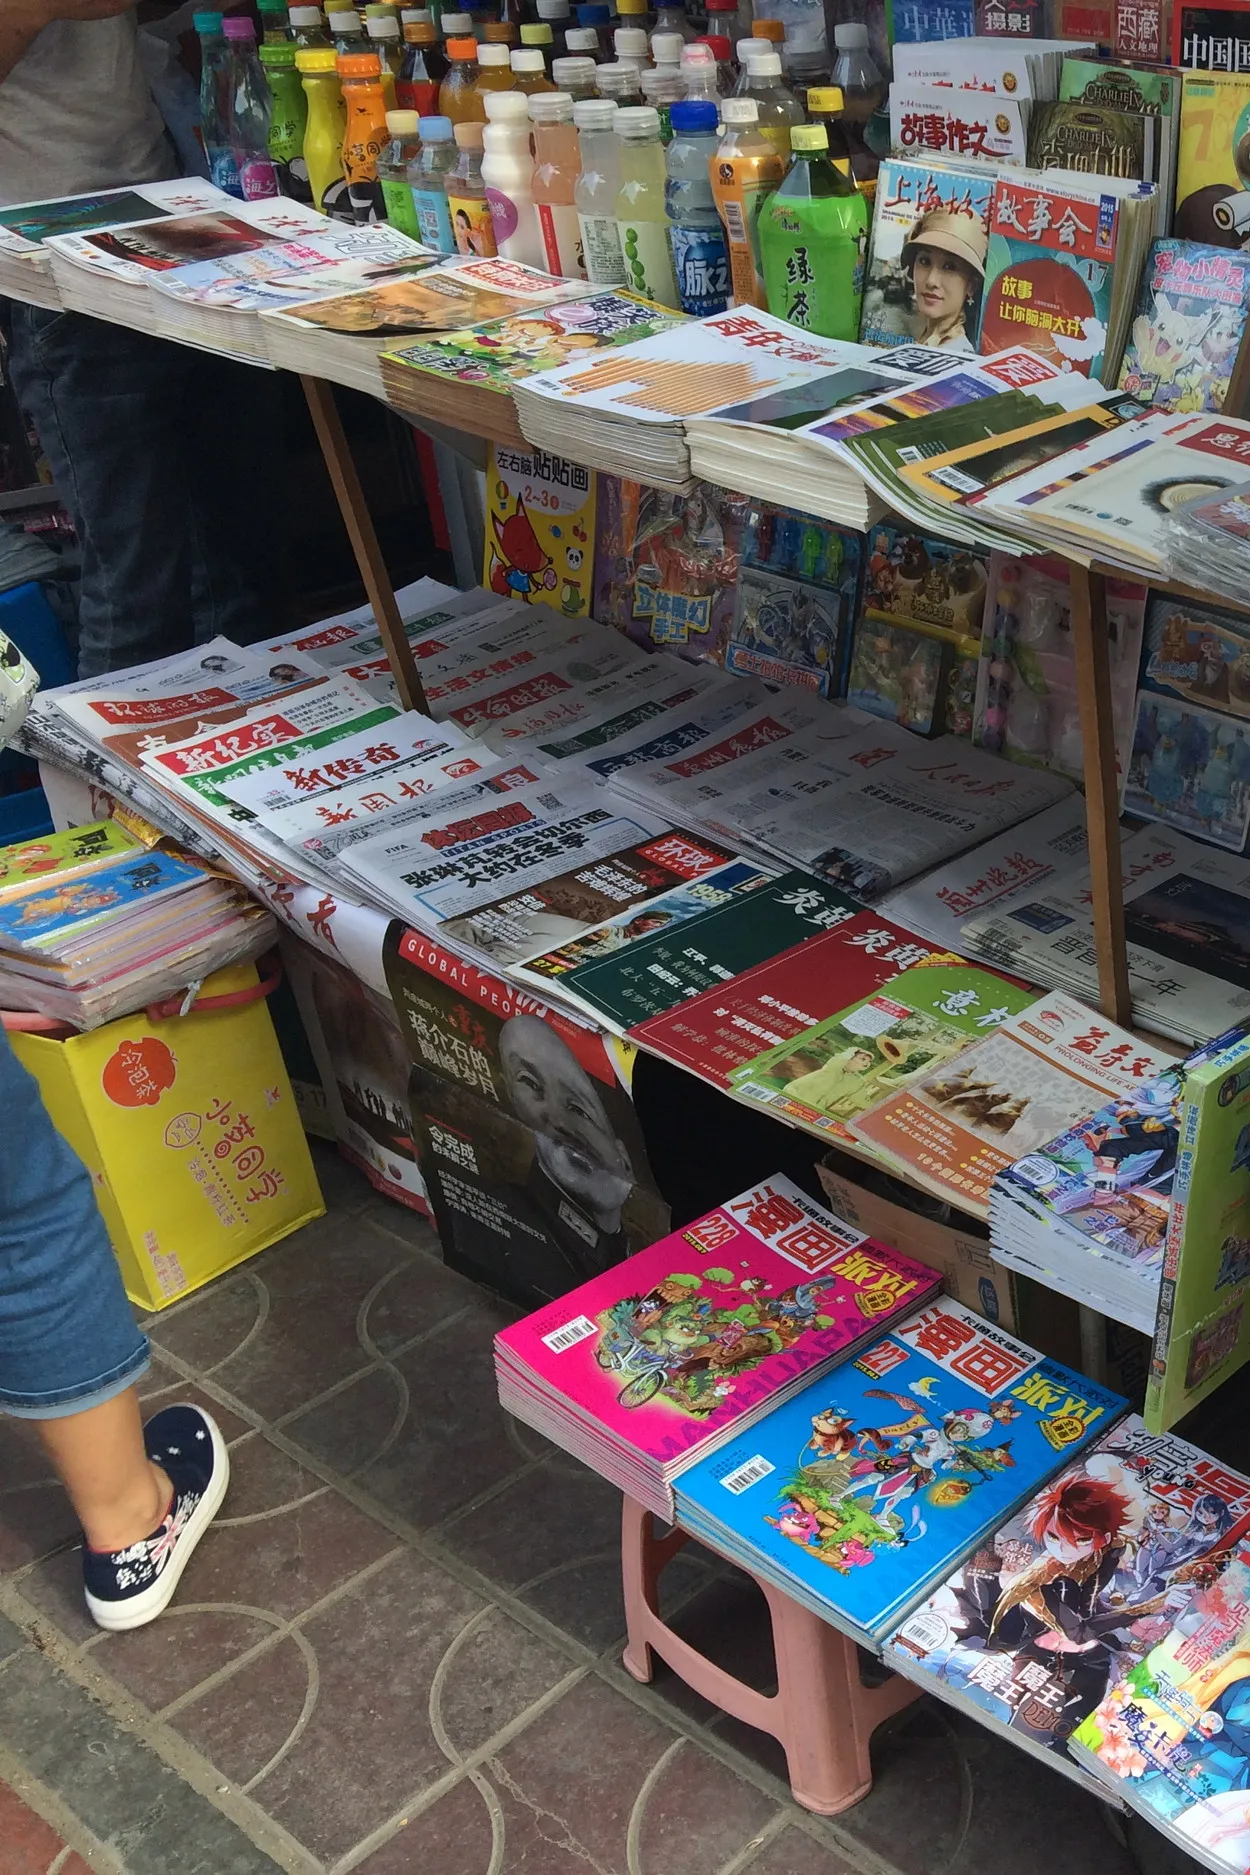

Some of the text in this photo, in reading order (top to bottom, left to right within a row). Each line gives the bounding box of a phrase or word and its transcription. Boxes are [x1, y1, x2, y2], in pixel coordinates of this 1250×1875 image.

[985, 12, 1030, 32] 摄影
[1118, 6, 1158, 41] 西藏
[900, 112, 1013, 157] 故事作文
[997, 188, 1093, 248] 故事会
[785, 247, 815, 327] 绿茶
[1002, 275, 1033, 300] 故事
[1086, 262, 1108, 285] 17
[1154, 251, 1244, 291] 宠物小精灵
[999, 301, 1081, 337] 让你脑洞大开
[497, 450, 589, 493] 左右脑贴贴画
[175, 722, 294, 773] 新纪实
[283, 743, 401, 792] 新传奇
[385, 843, 409, 855] FIFA
[458, 832, 591, 888] 大约在冬季
[406, 938, 469, 988] GLOBAL
[842, 929, 931, 970] 炎黄
[407, 1009, 491, 1078] 蒋介石的
[1054, 1046, 1126, 1087] PROLONGING LIFE
[1068, 1026, 1163, 1078] 益寿文
[417, 1036, 500, 1102] 巅峰岁月
[206, 1098, 286, 1202] 小茗同学
[693, 1216, 738, 1250] 228
[730, 1185, 852, 1271] 漫画
[791, 1195, 861, 1244] 卡通故事会
[830, 1250, 918, 1298] 派对
[898, 1306, 1029, 1395] 漫画
[959, 1313, 1037, 1364] 卡通故事会
[1009, 1371, 1106, 1425] 派对
